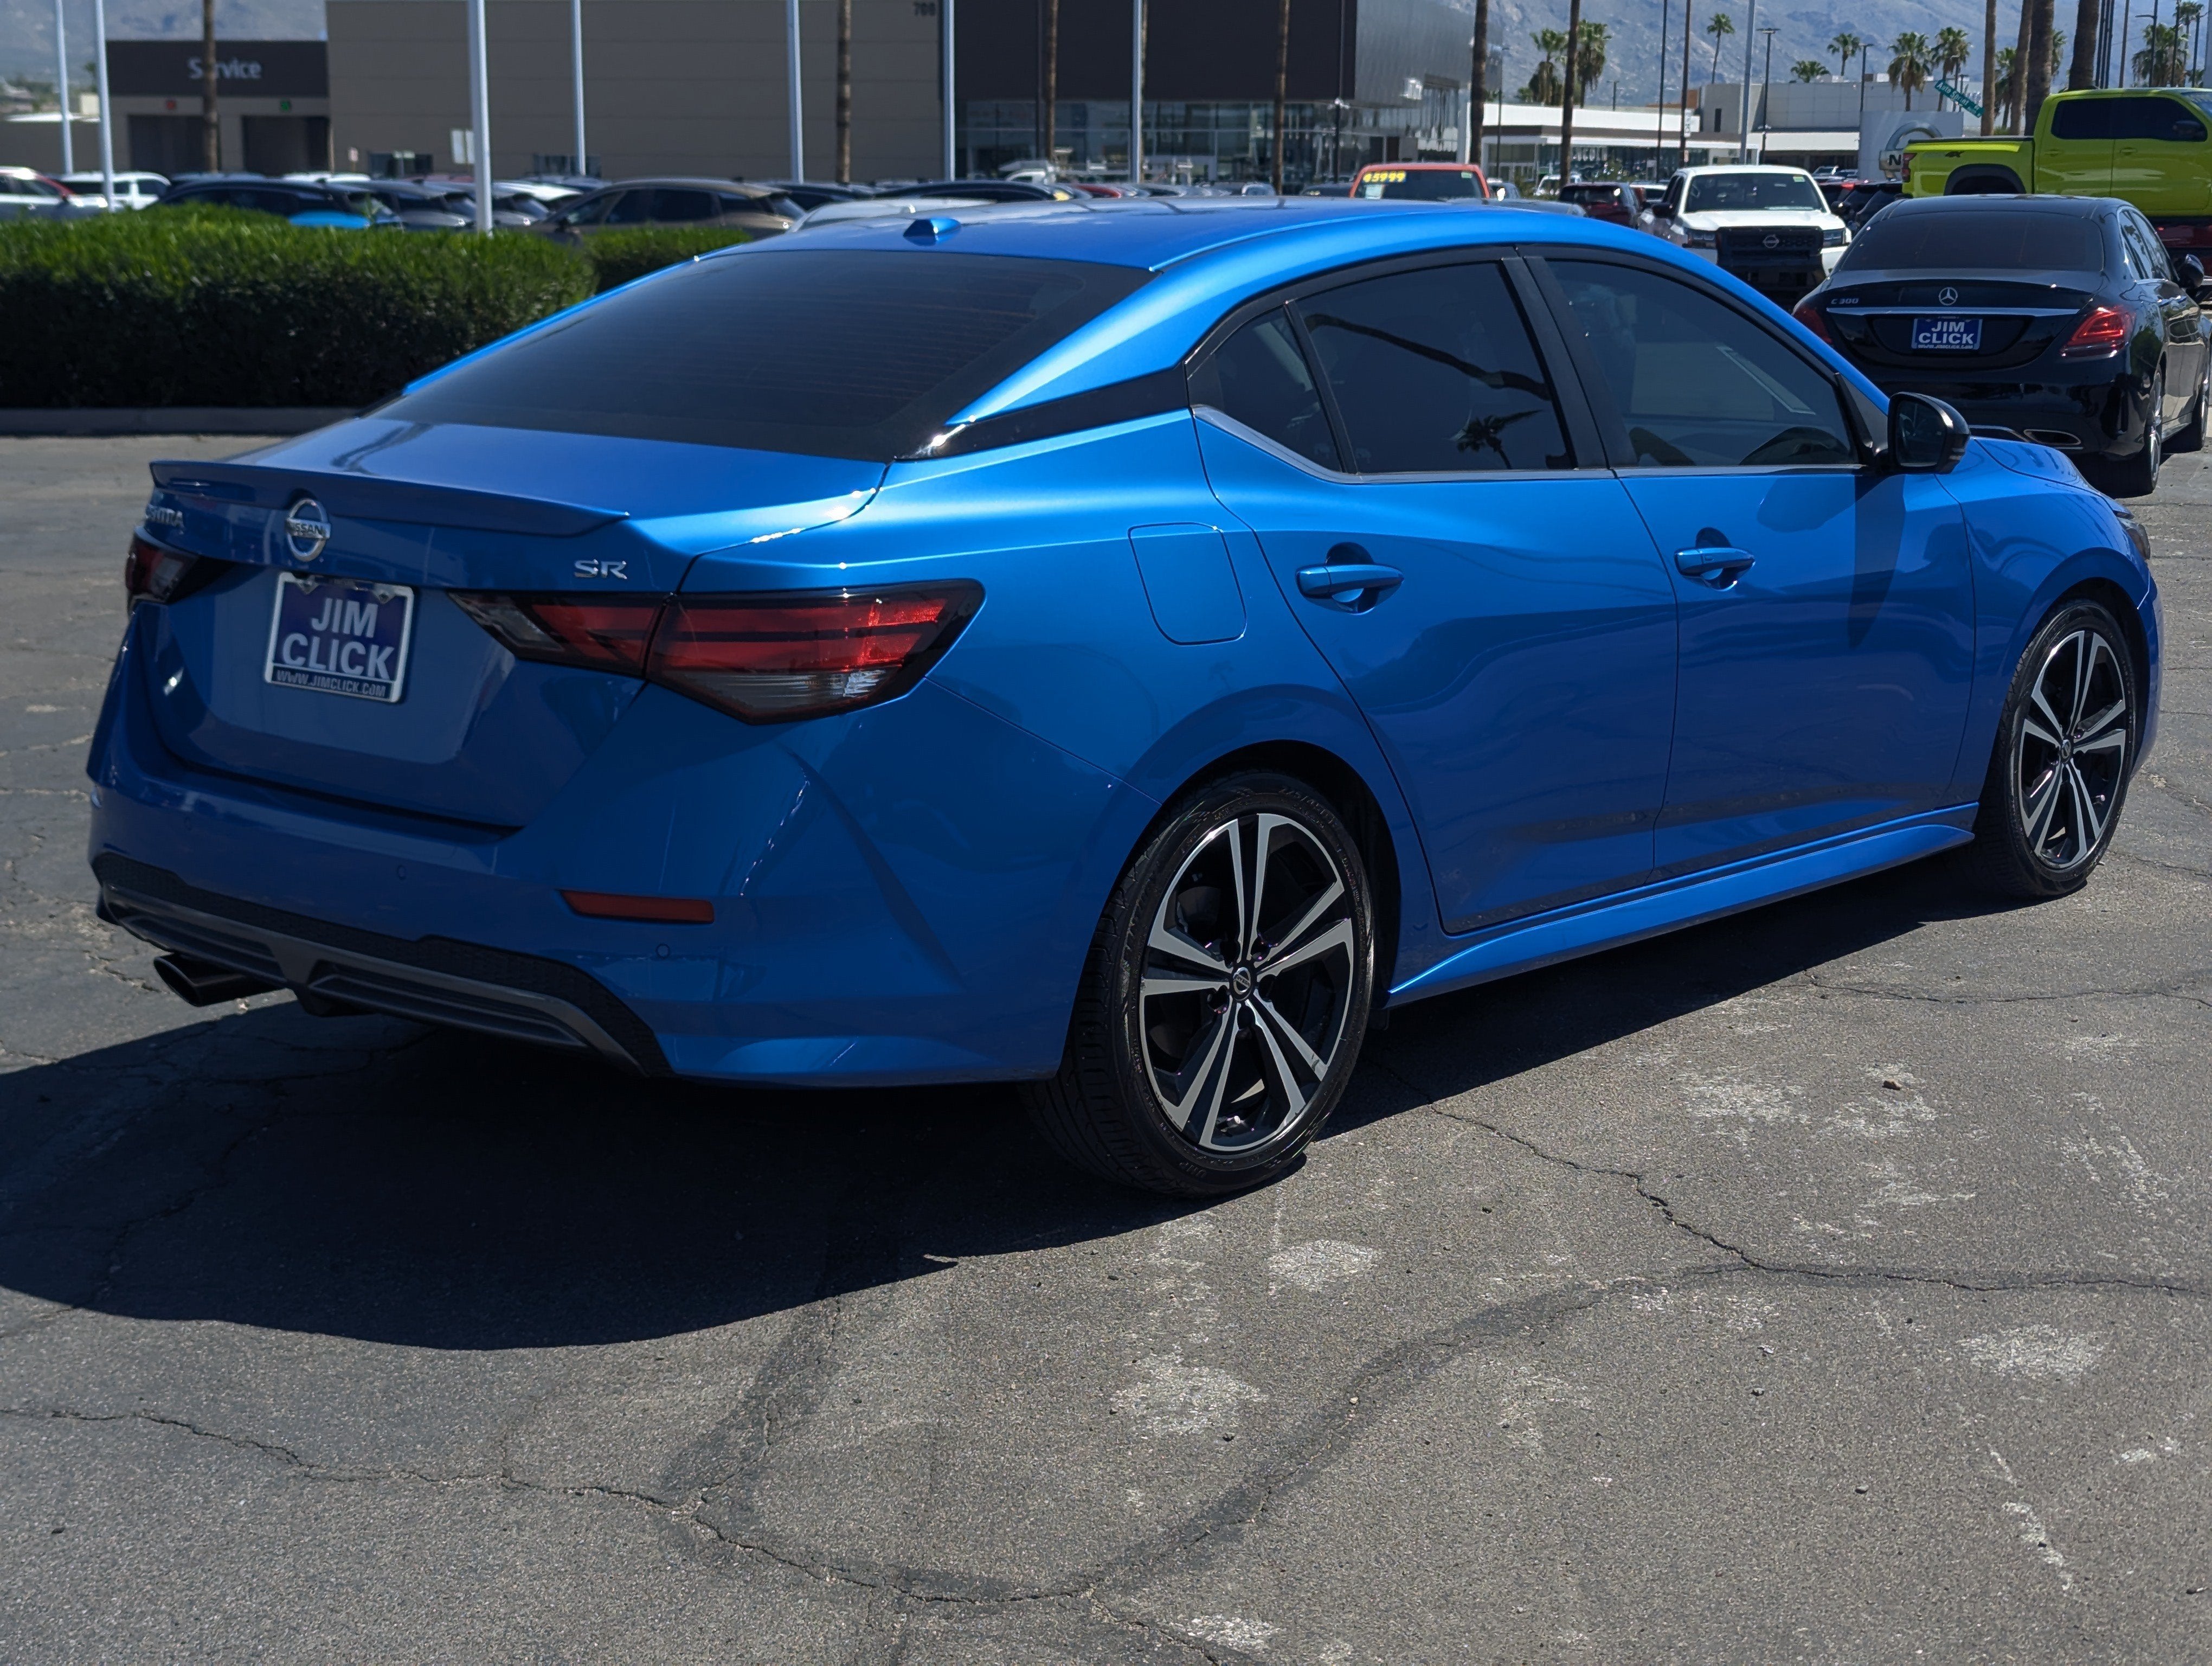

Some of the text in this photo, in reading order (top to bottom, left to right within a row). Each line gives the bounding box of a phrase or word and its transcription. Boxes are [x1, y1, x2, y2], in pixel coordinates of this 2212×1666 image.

[188, 56, 262, 80] Srvice
[1931, 321, 1965, 332] JIM
[1918, 332, 1975, 344] CLICK
[286, 521, 325, 538] SSAN
[574, 559, 627, 579] SR
[311, 597, 378, 638] JIM
[282, 632, 395, 681] CLICK
[276, 669, 387, 697] WWW.JIMCLICK.COM
